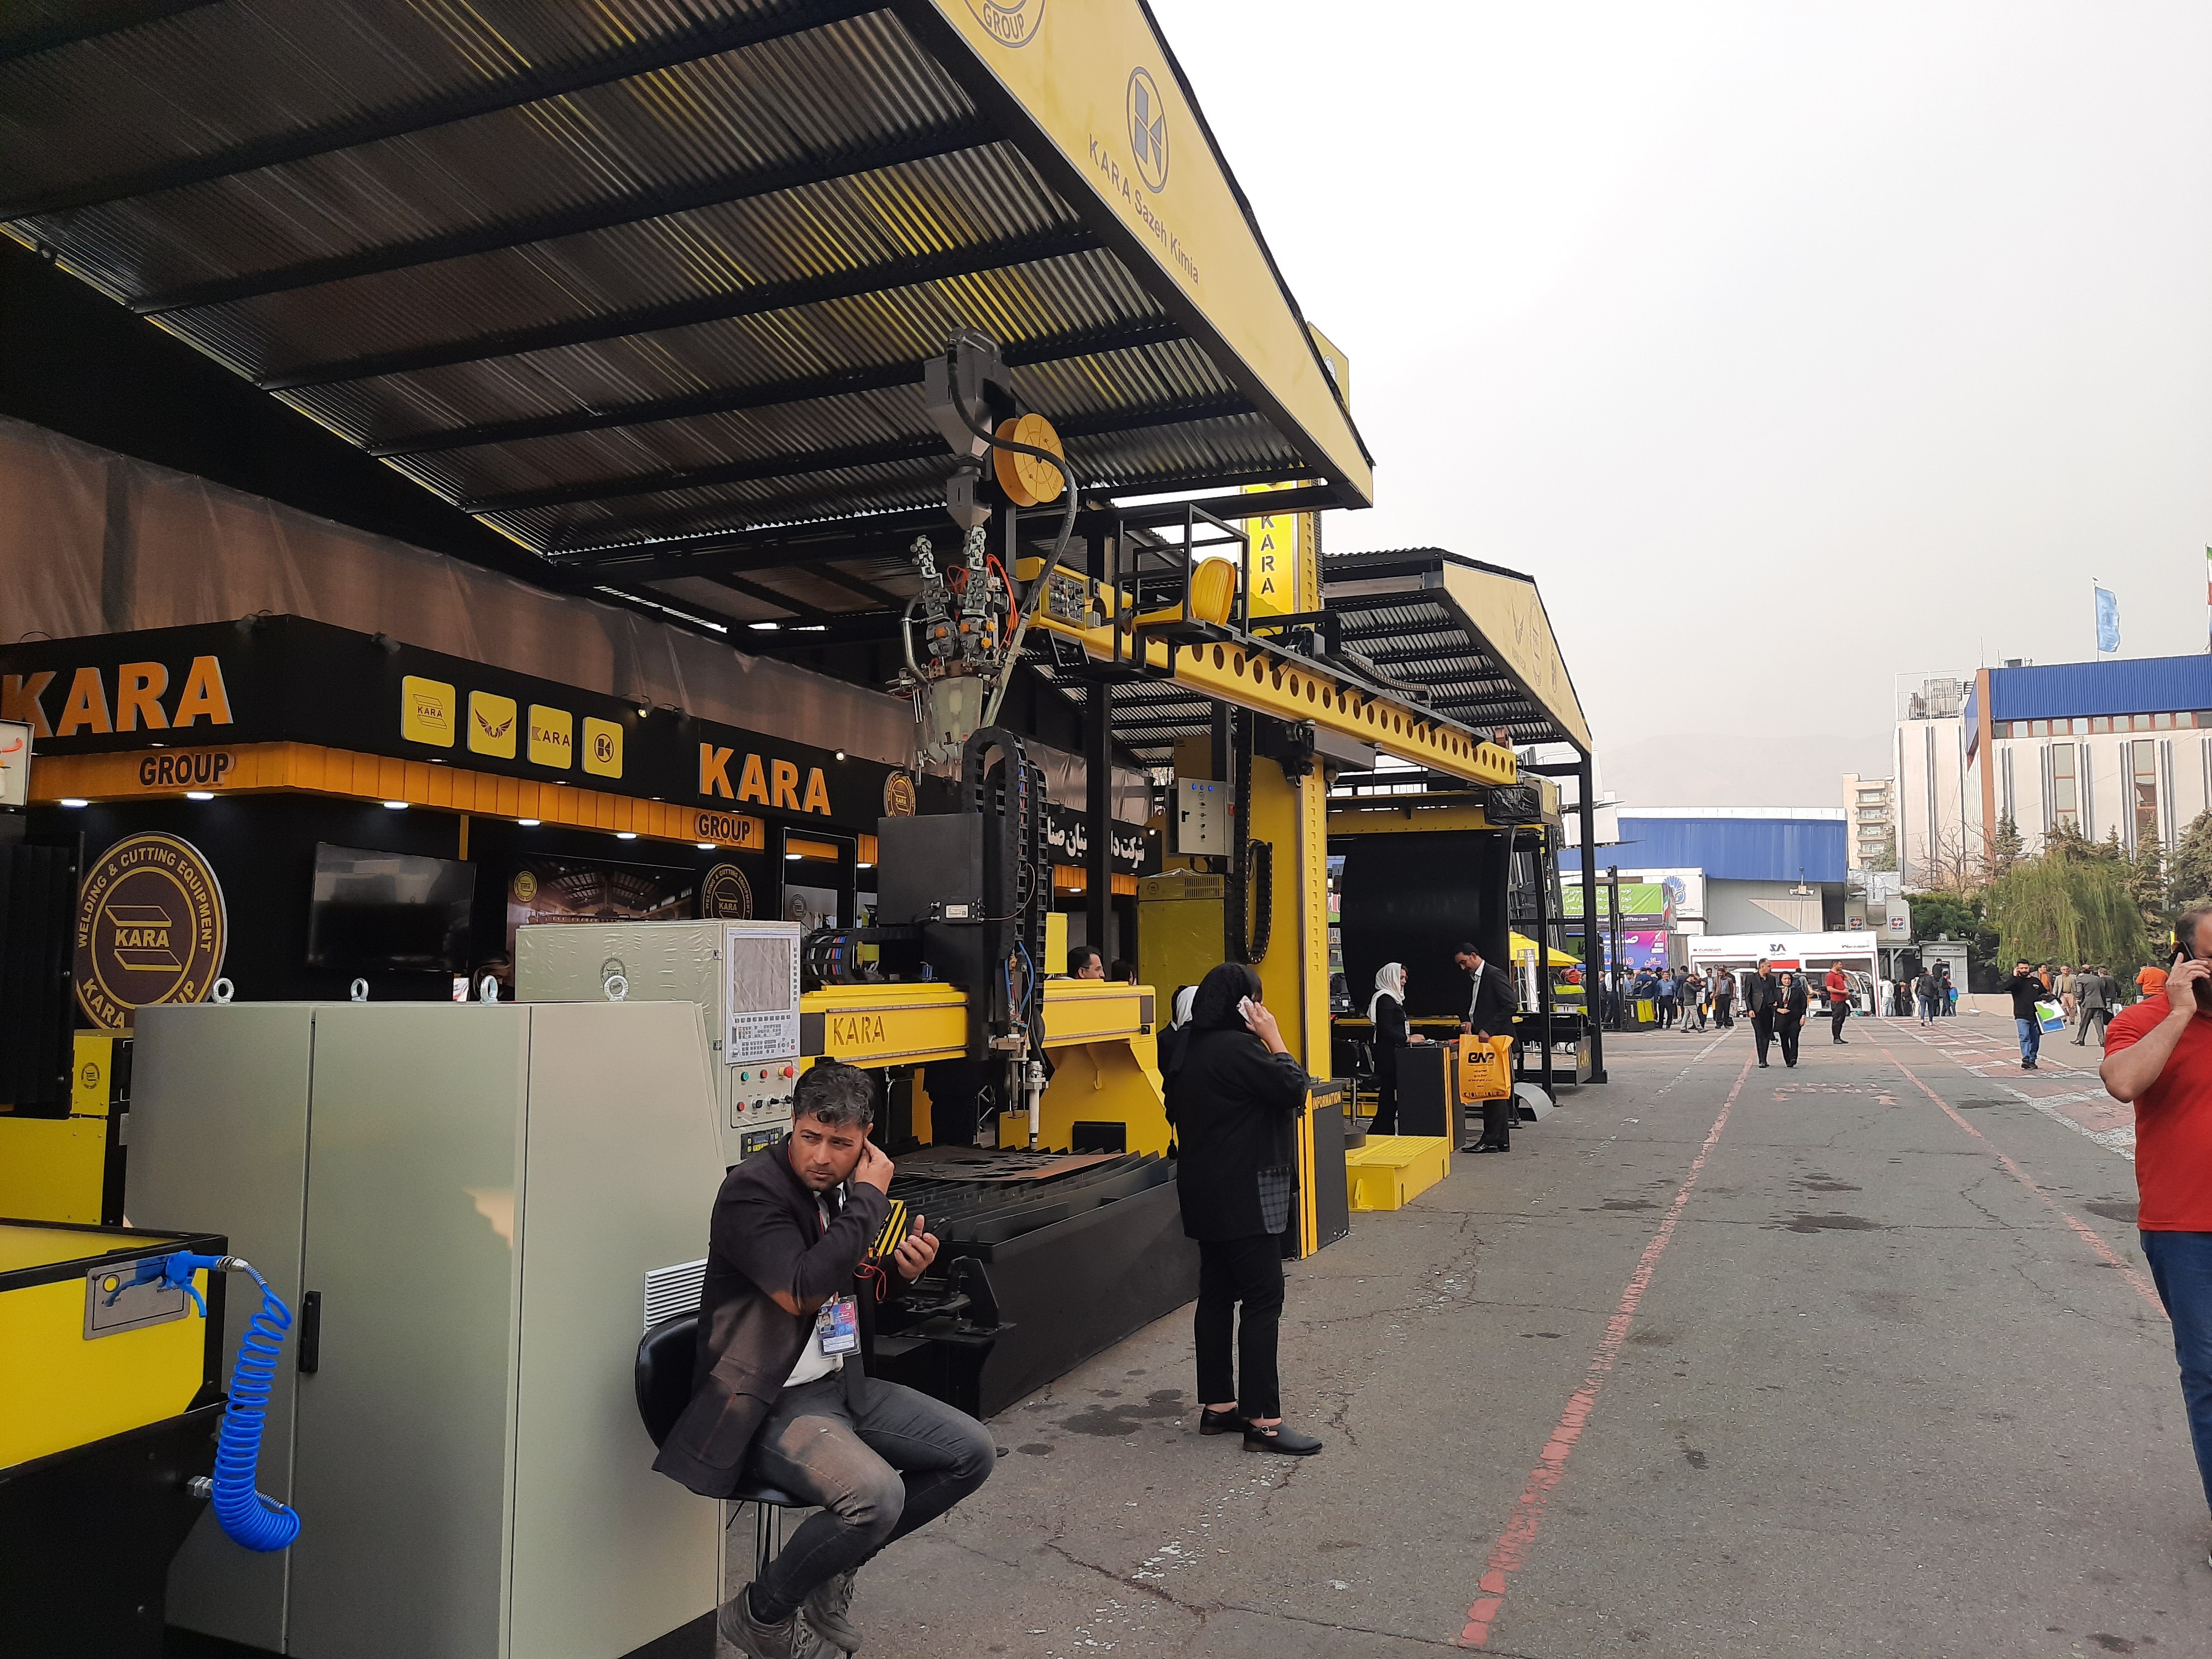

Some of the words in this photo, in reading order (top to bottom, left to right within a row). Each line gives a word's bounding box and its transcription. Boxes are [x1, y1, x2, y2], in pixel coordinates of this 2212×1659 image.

[983, 3, 1024, 39] GROUP
[1089, 133, 1131, 205] KARA
[1134, 189, 1167, 248] Sazeh
[1170, 232, 1199, 286] Kimia
[1260, 515, 1275, 595] KARA
[1, 655, 234, 738] KARA
[418, 706, 442, 718] KARA
[140, 753, 229, 786] GROUP
[699, 742, 832, 816] KARA
[698, 814, 750, 842] GROUP
[1120, 836, 1145, 869] شرکت
[79, 875, 107, 948] WELDING
[108, 863, 118, 877] &
[121, 847, 177, 866] CUTTING
[176, 859, 213, 953] EQUIPMENT
[705, 878, 716, 910] WELDING
[719, 868, 738, 878] CUTTING
[738, 875, 750, 914] EQUIPMENT
[719, 902, 737, 911] KARA
[114, 929, 170, 947] KARA
[83, 978, 126, 1029] KARA
[833, 1015, 885, 1046] KARA
[1578, 1048, 1590, 1069] KARA
[1312, 1091, 1341, 1110] INFORMATION
